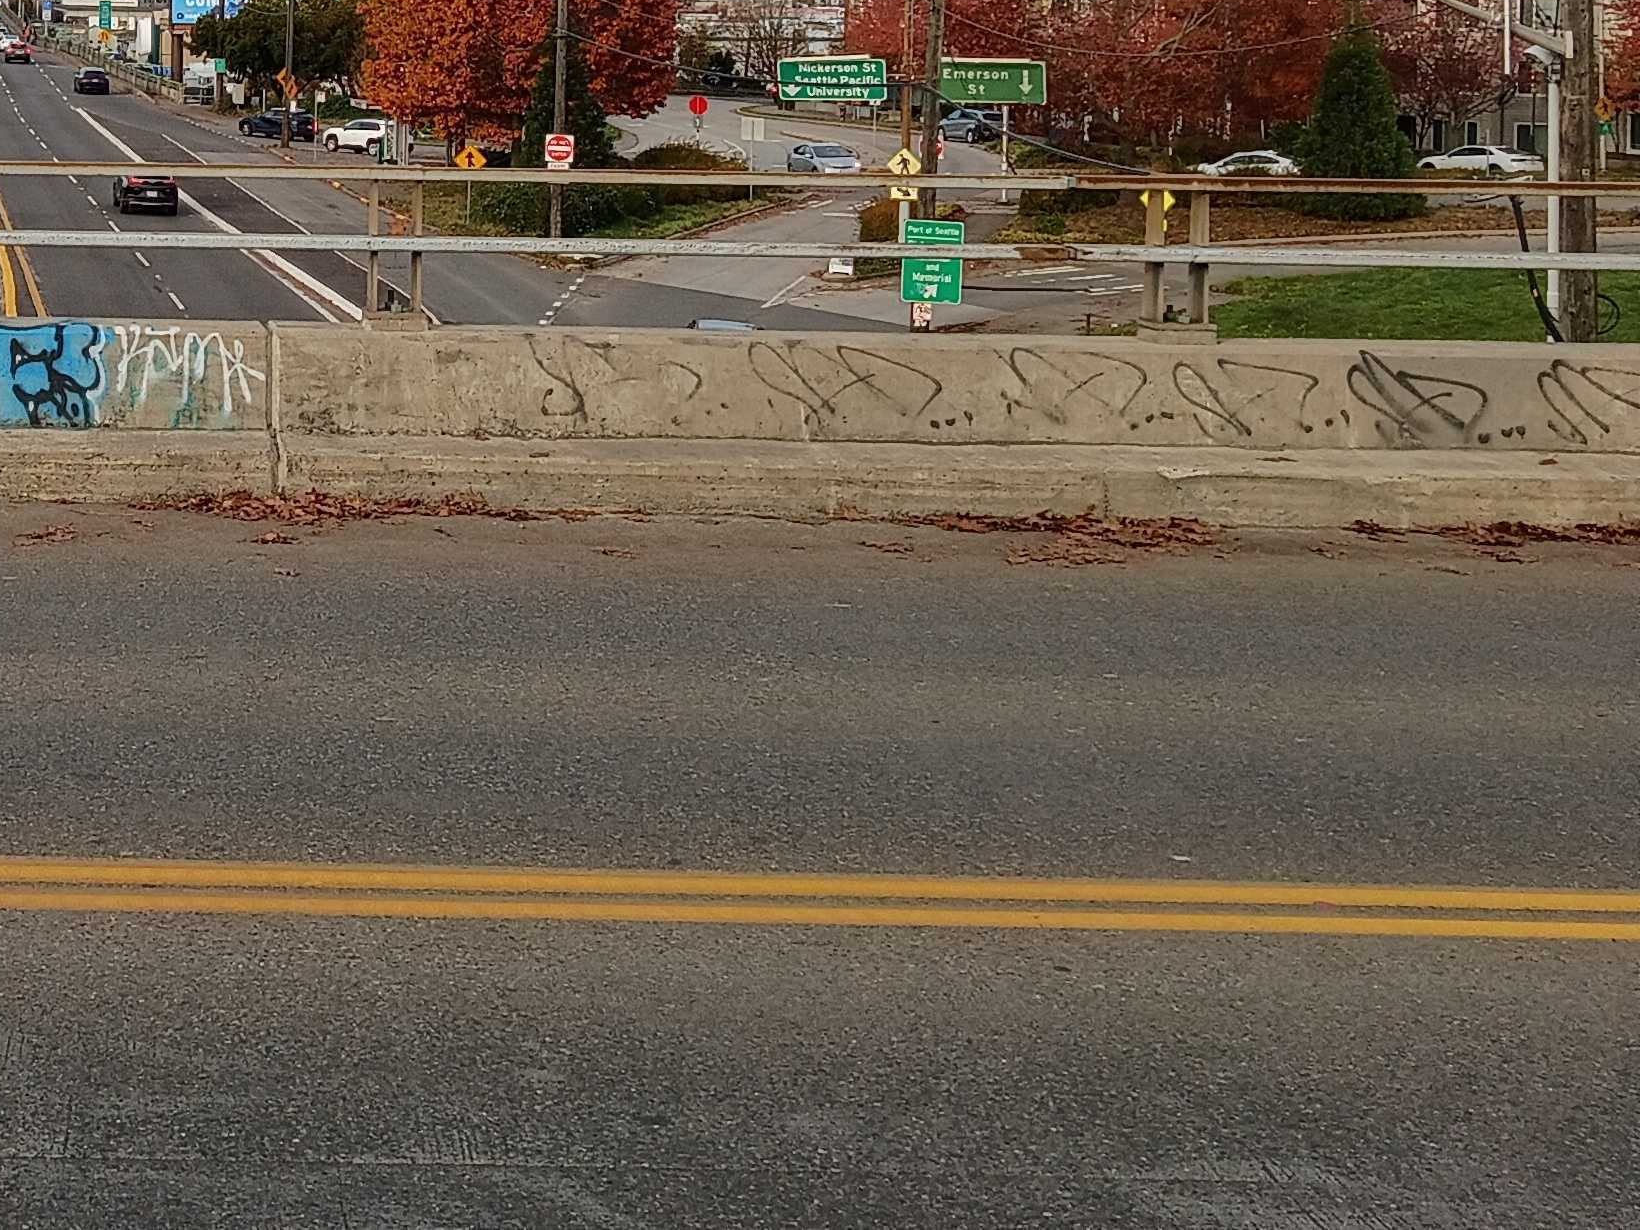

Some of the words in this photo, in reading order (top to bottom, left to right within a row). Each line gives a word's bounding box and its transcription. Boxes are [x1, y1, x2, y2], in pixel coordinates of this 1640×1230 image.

[798, 63, 858, 73] Nickerson
[862, 62, 877, 73] St
[942, 68, 1009, 80] Emerson
[840, 75, 882, 85] Pacific
[806, 86, 870, 99] University
[967, 83, 985, 95] St
[912, 272, 952, 283] Memorial
